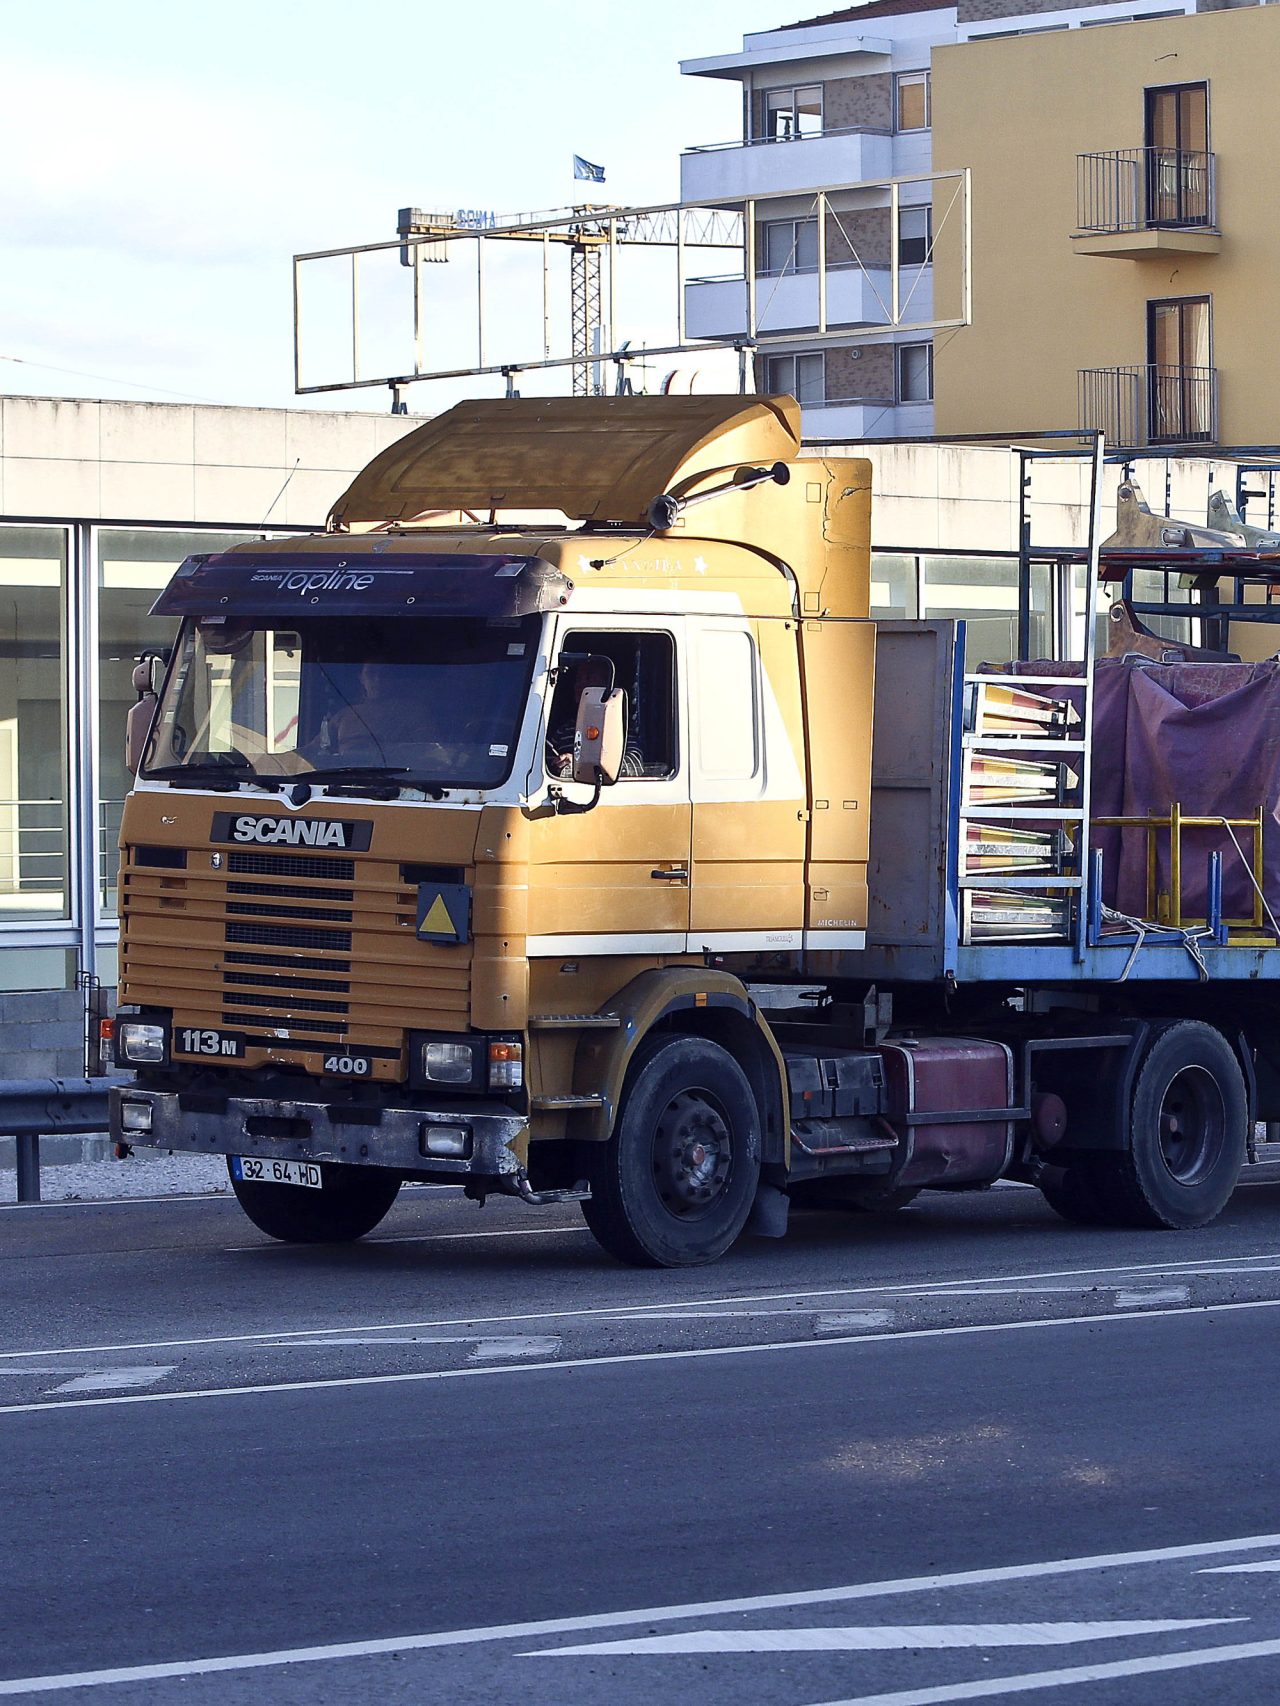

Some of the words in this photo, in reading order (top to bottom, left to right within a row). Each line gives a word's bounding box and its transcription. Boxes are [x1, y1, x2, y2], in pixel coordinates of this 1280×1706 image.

[278, 569, 375, 596] Topline
[233, 816, 346, 847] SCANIA
[817, 919, 857, 927] MICHELIN
[325, 1056, 368, 1075] 400
